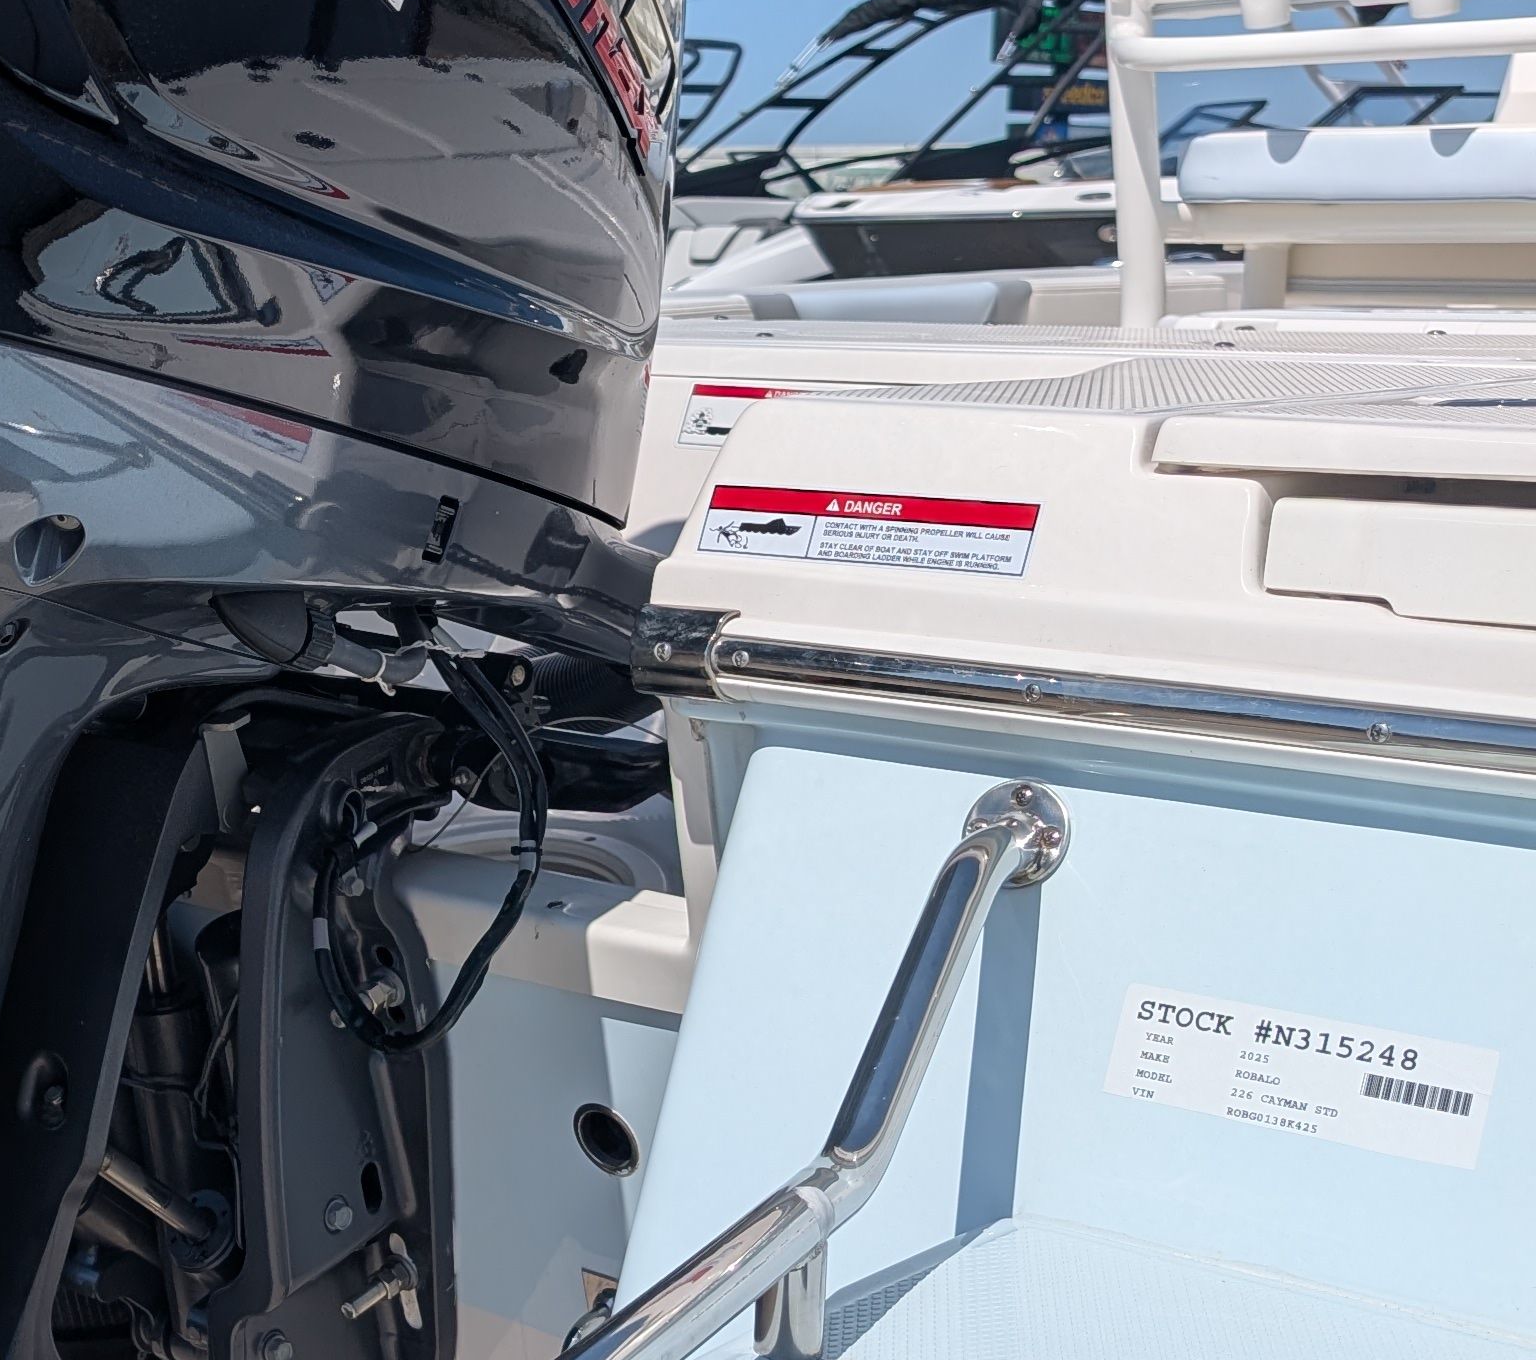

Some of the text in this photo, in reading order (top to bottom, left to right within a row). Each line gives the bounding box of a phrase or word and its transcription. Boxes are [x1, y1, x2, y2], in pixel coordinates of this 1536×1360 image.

[843, 500, 904, 515] DANGER
[822, 528, 854, 537] SERIOUS
[853, 531, 880, 539] INJURY
[824, 521, 858, 530] CONTACT
[858, 523, 878, 531] WITH
[884, 525, 919, 534] SPINNING
[919, 528, 964, 537] PROPELLER
[964, 531, 984, 539] WILL
[983, 532, 1011, 541] CAUSE
[816, 548, 833, 557] AND
[832, 550, 871, 560] BOARDING
[871, 553, 902, 562] LADDER
[902, 555, 926, 564] WHILE
[925, 557, 955, 566] ENGINE
[819, 541, 1012, 563] STAY CLEAR OF BOAT AND STAY OFF SWIM PLATFORM
[1137, 1000, 1419, 1072] STOCK #N315248
[1144, 1031, 1270, 1064] YEAR 2025
[1140, 1050, 1281, 1086] MAKE ROBALO
[1135, 1067, 1339, 1119] MODEL 226 CAYMAN STD
[1132, 1086, 1318, 1134] VIN ROBG0138K425
